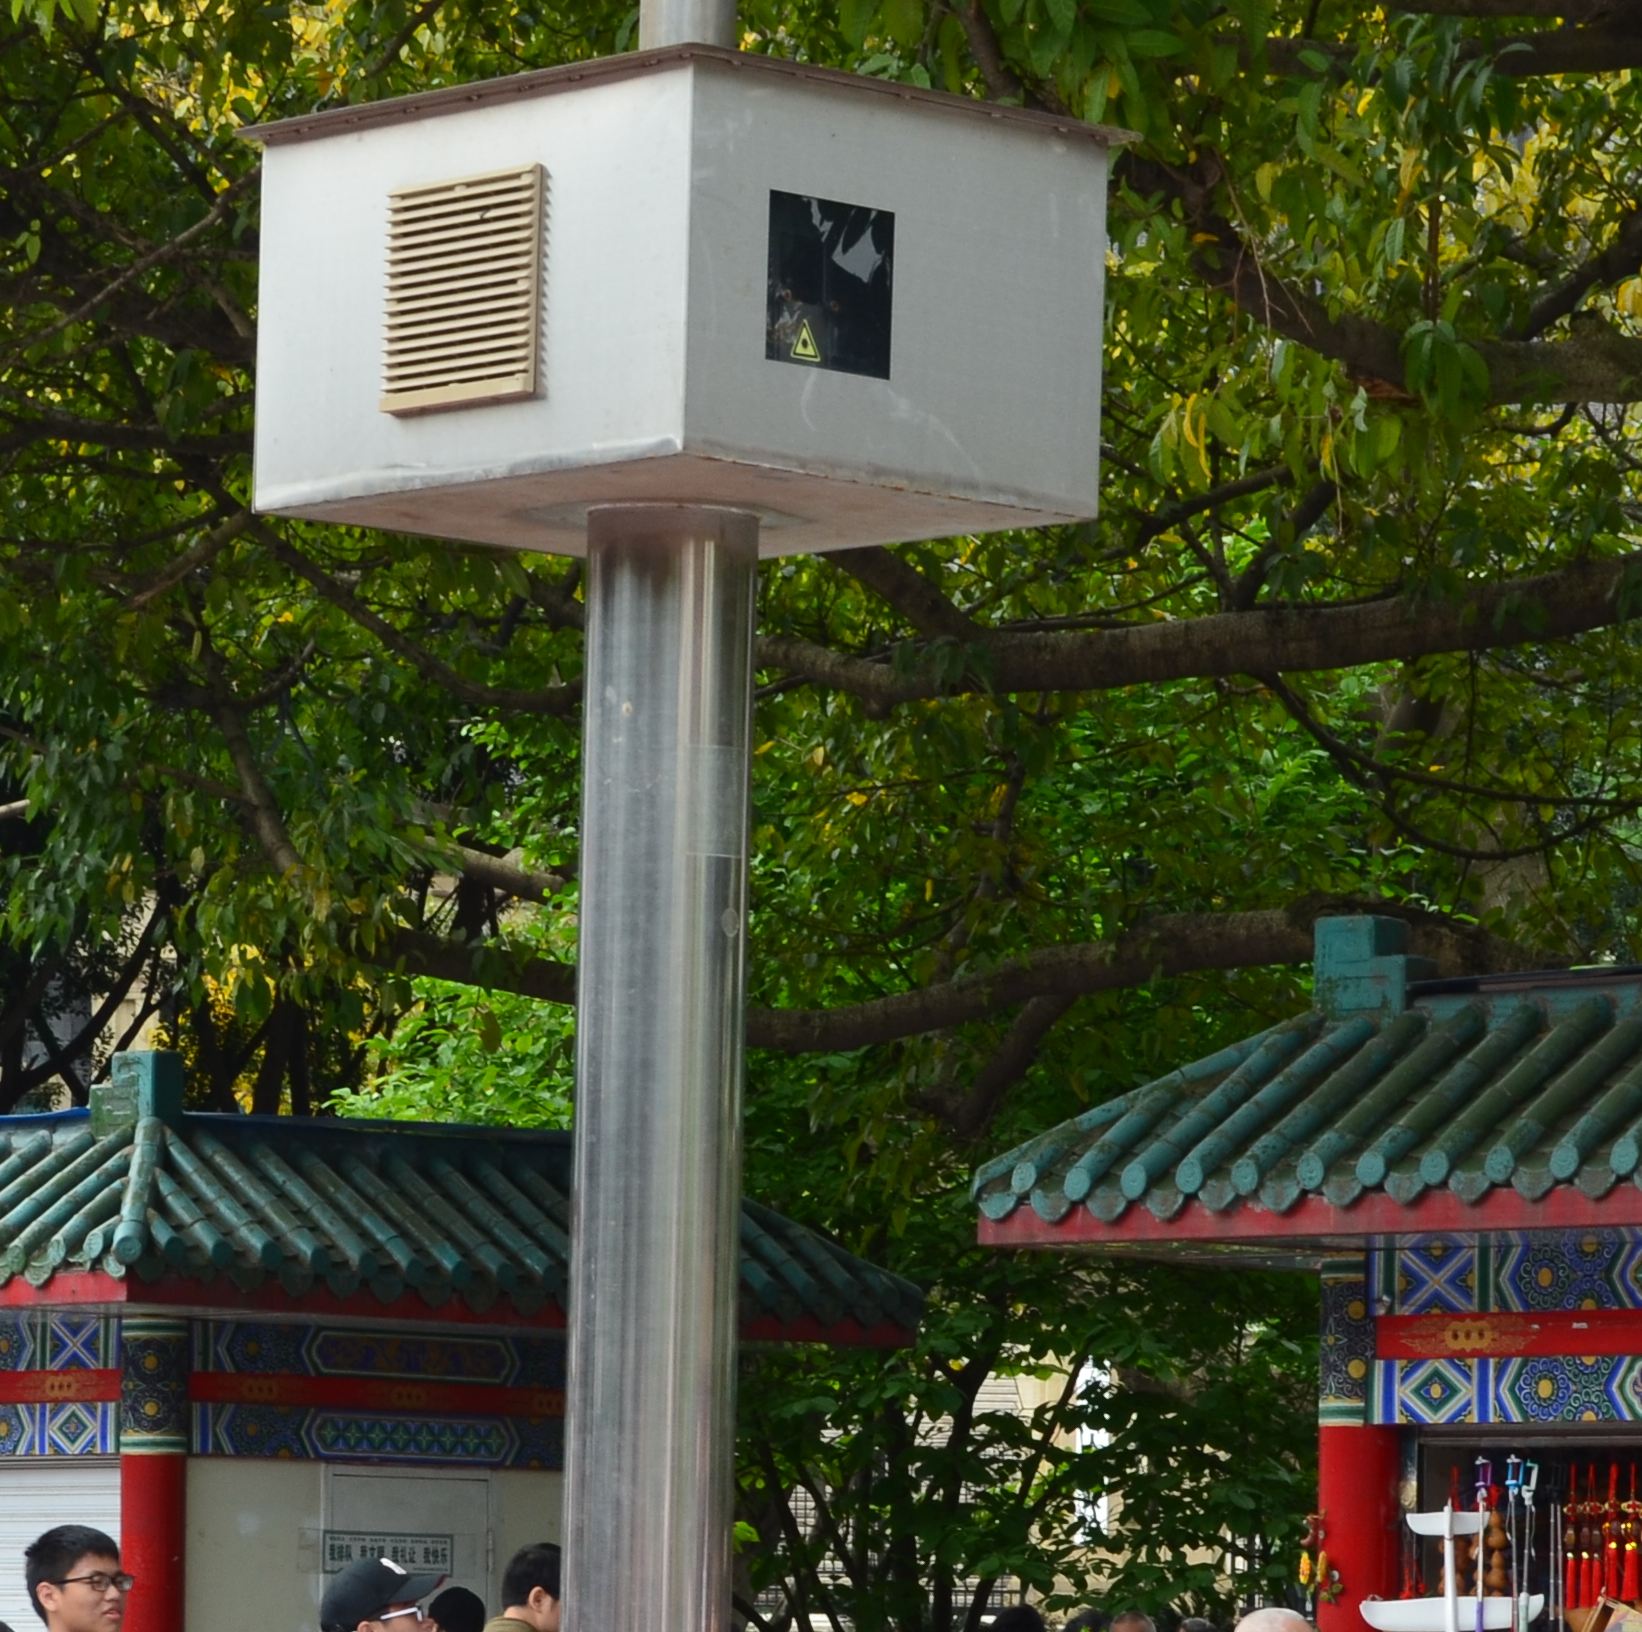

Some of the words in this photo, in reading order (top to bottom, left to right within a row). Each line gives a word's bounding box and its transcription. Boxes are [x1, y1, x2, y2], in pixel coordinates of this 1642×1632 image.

[328, 1543, 353, 1561] 我排队
[391, 1546, 416, 1564] 我礼让
[423, 1547, 448, 1565] 我快乐
